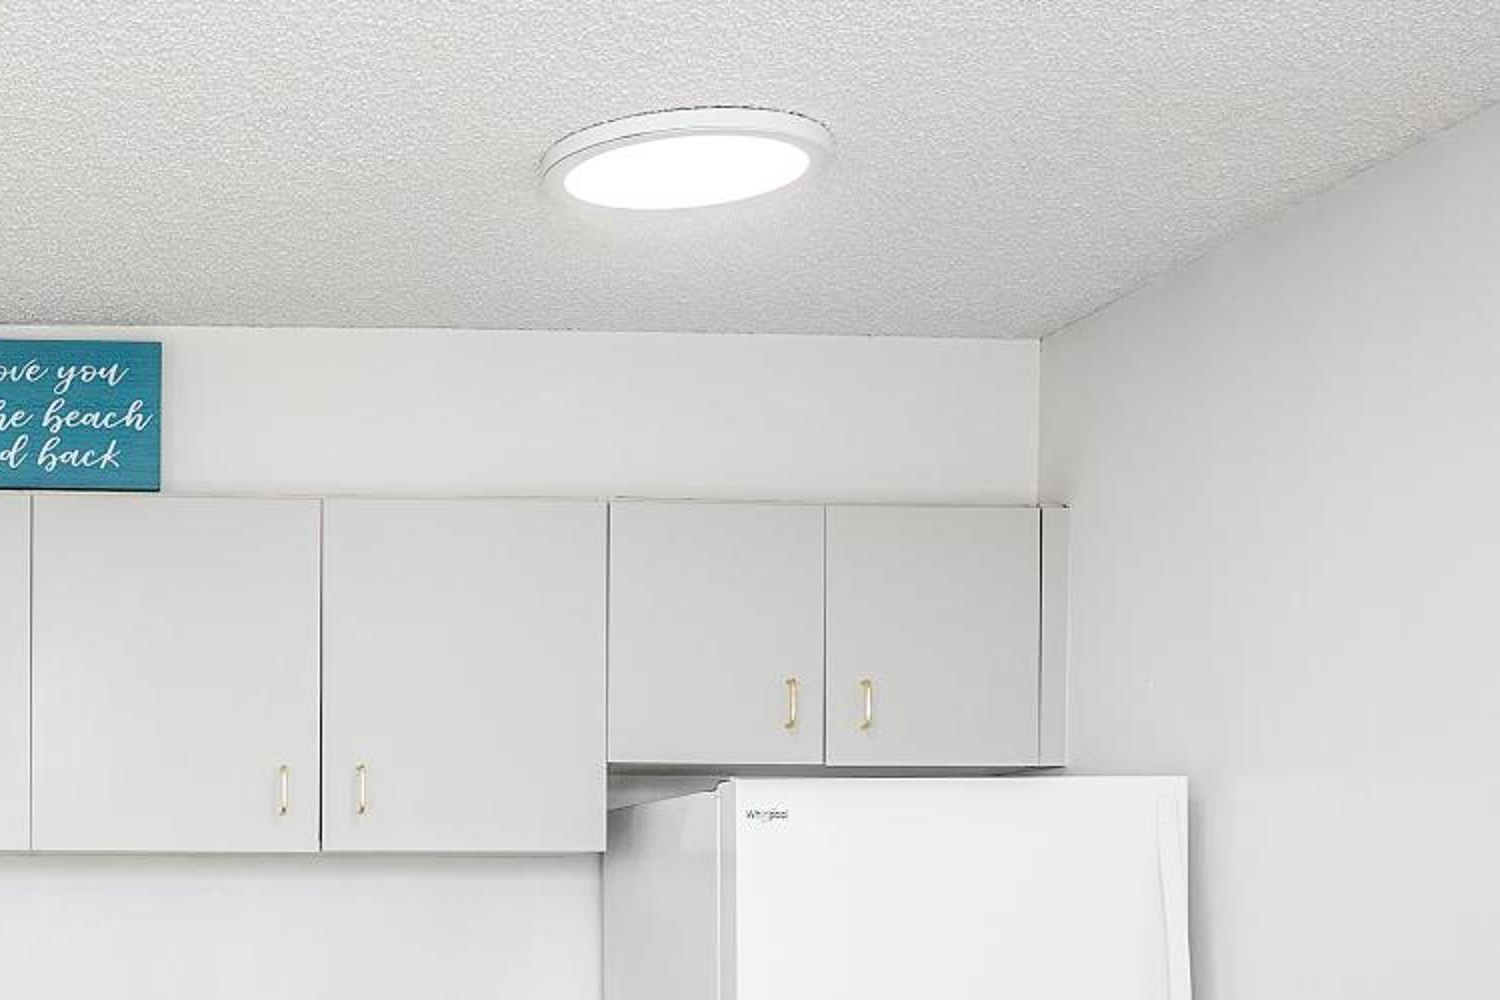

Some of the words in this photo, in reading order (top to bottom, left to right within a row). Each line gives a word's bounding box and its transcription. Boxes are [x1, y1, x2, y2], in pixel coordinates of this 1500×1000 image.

[53, 361, 129, 395] you
[42, 397, 154, 433] beach
[37, 436, 120, 473] back
